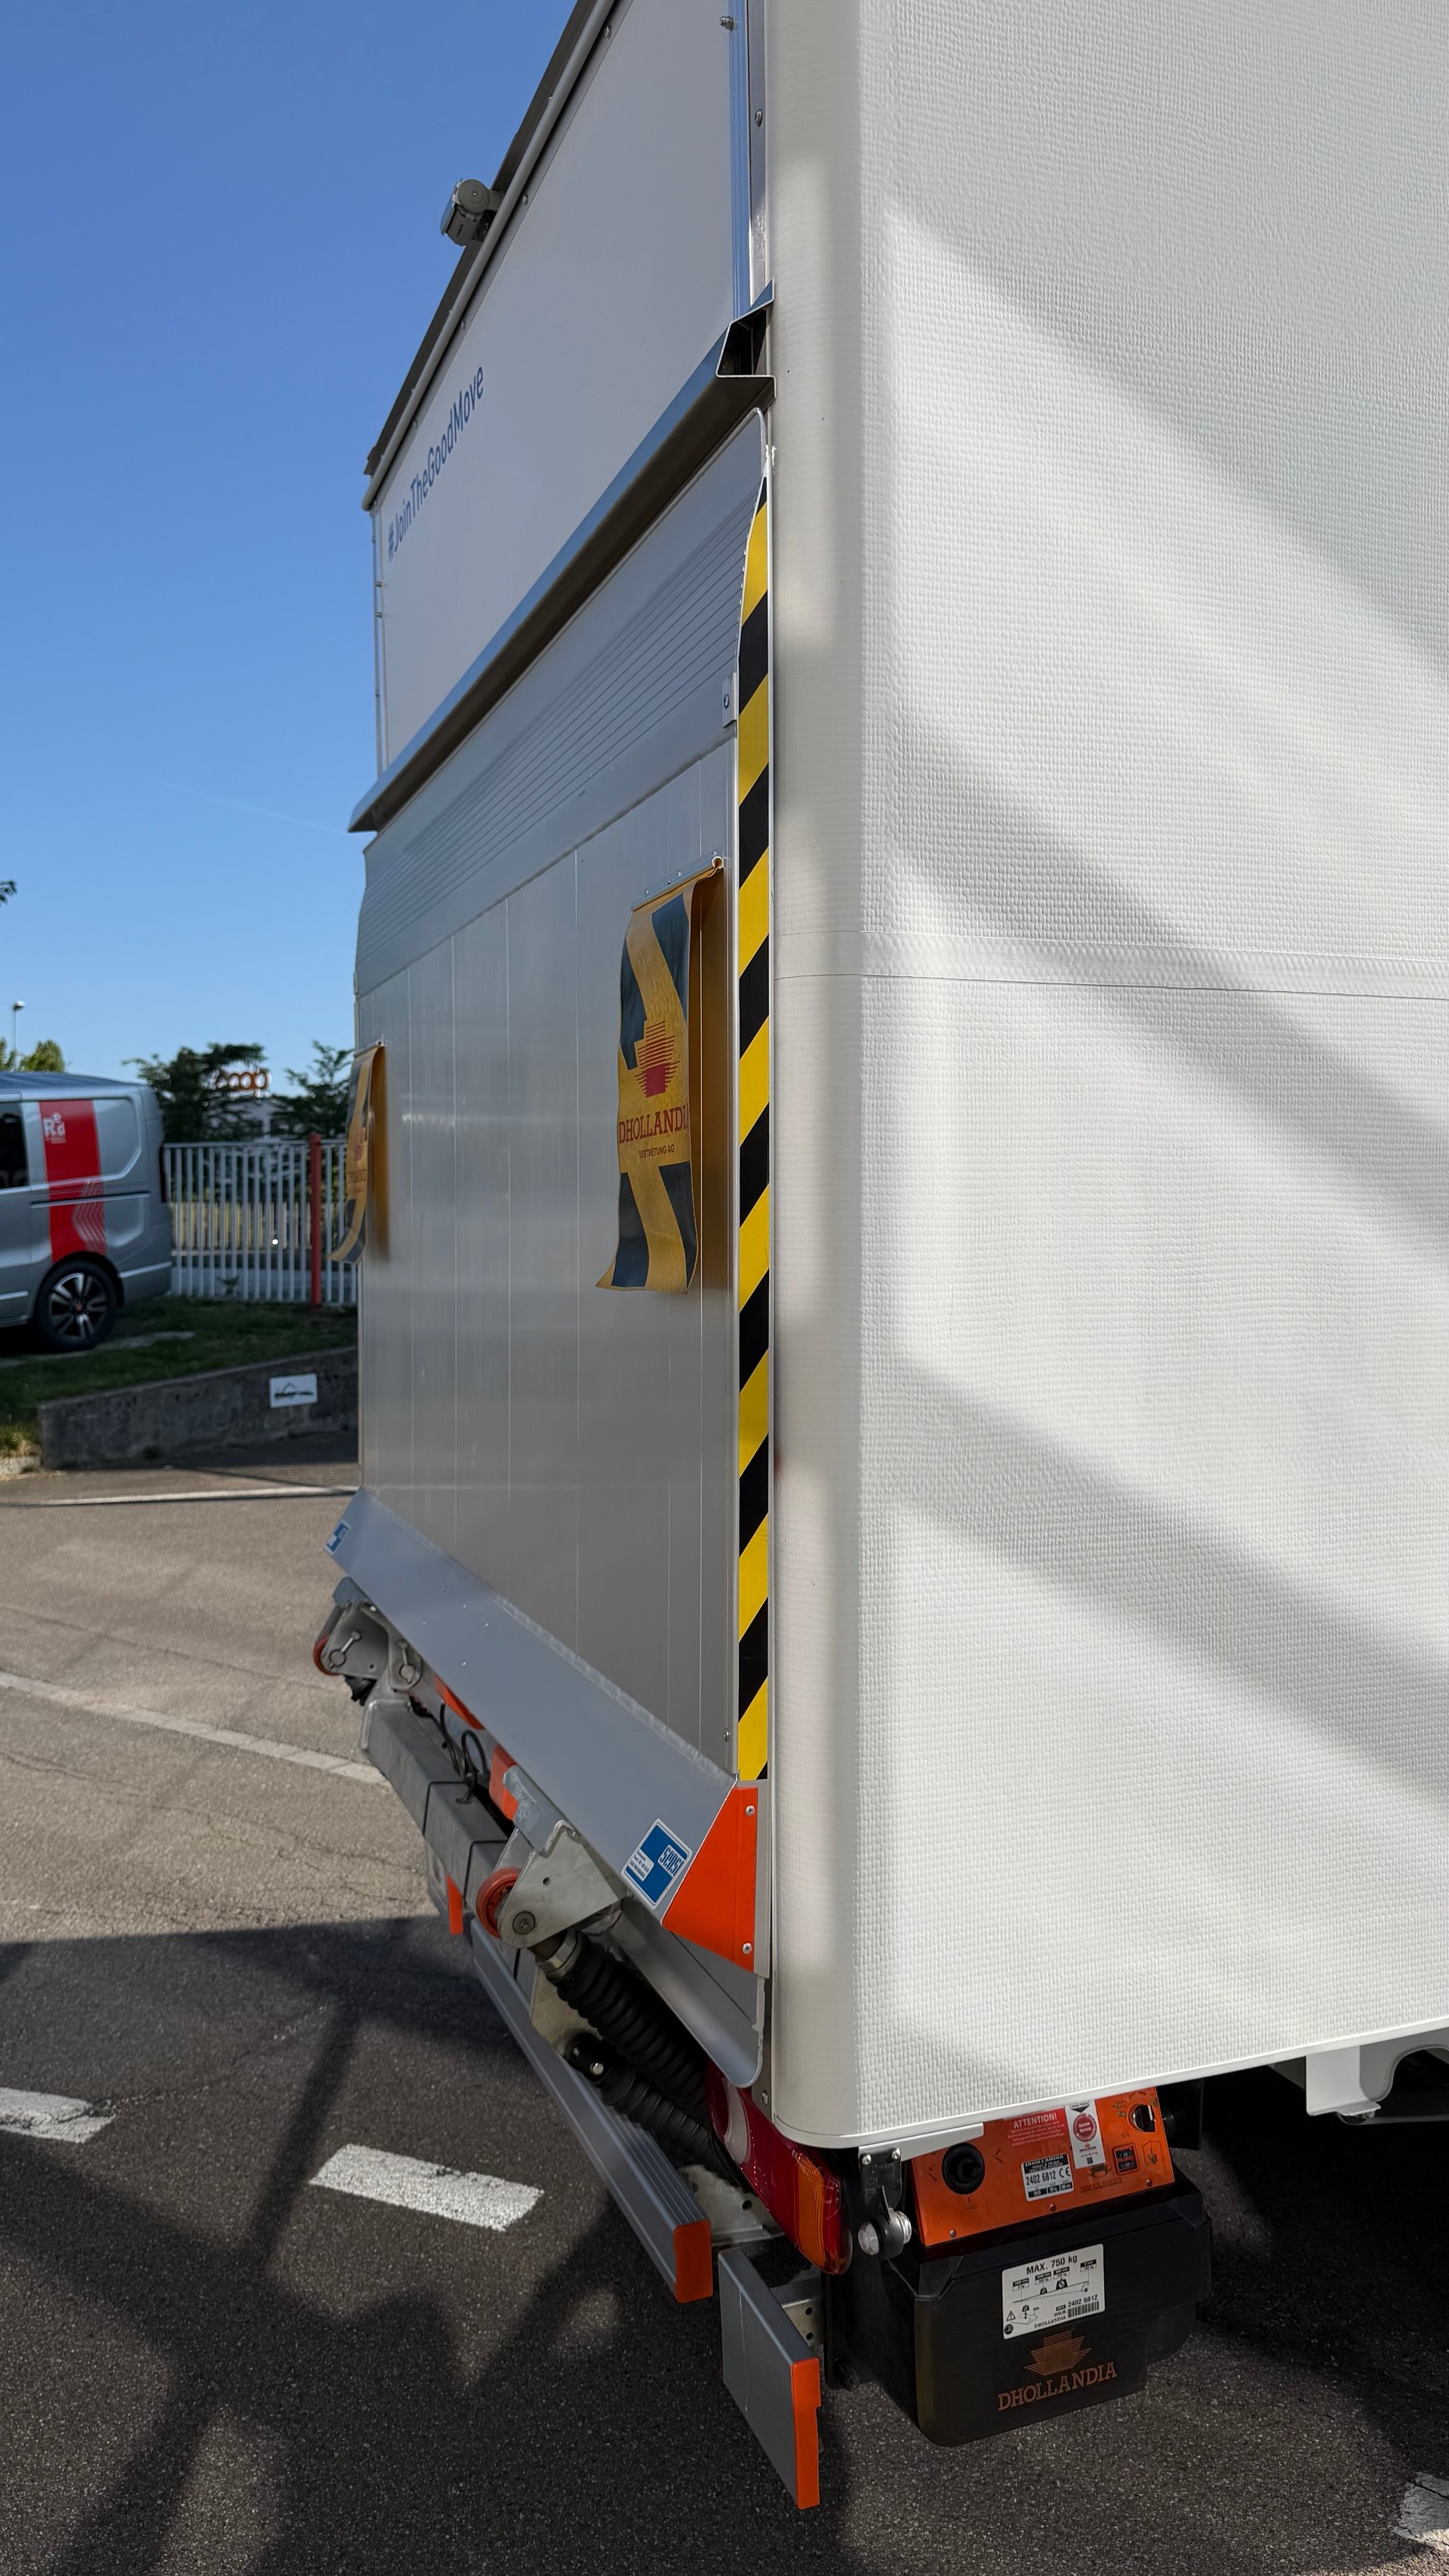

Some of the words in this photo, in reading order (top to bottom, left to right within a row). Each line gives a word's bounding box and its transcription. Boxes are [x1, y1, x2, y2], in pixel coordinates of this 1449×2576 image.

[388, 366, 484, 562] #JoinTheGoodMove
[638, 1146, 666, 1159] VERTRETUNG
[668, 1144, 675, 1153] AG
[1026, 2174, 1041, 2186] 2402
[1041, 2171, 1057, 2182] 6812
[1026, 2261, 1048, 2275] MAX.
[1051, 2256, 1065, 2268] 750
[1068, 2254, 1077, 2264] kg
[1067, 2298, 1081, 2307] 2402
[1083, 2294, 1098, 2304] 6812
[1034, 2316, 1066, 2328] DHOLLANDIA
[998, 2362, 1117, 2411] DHOLLANDIA
